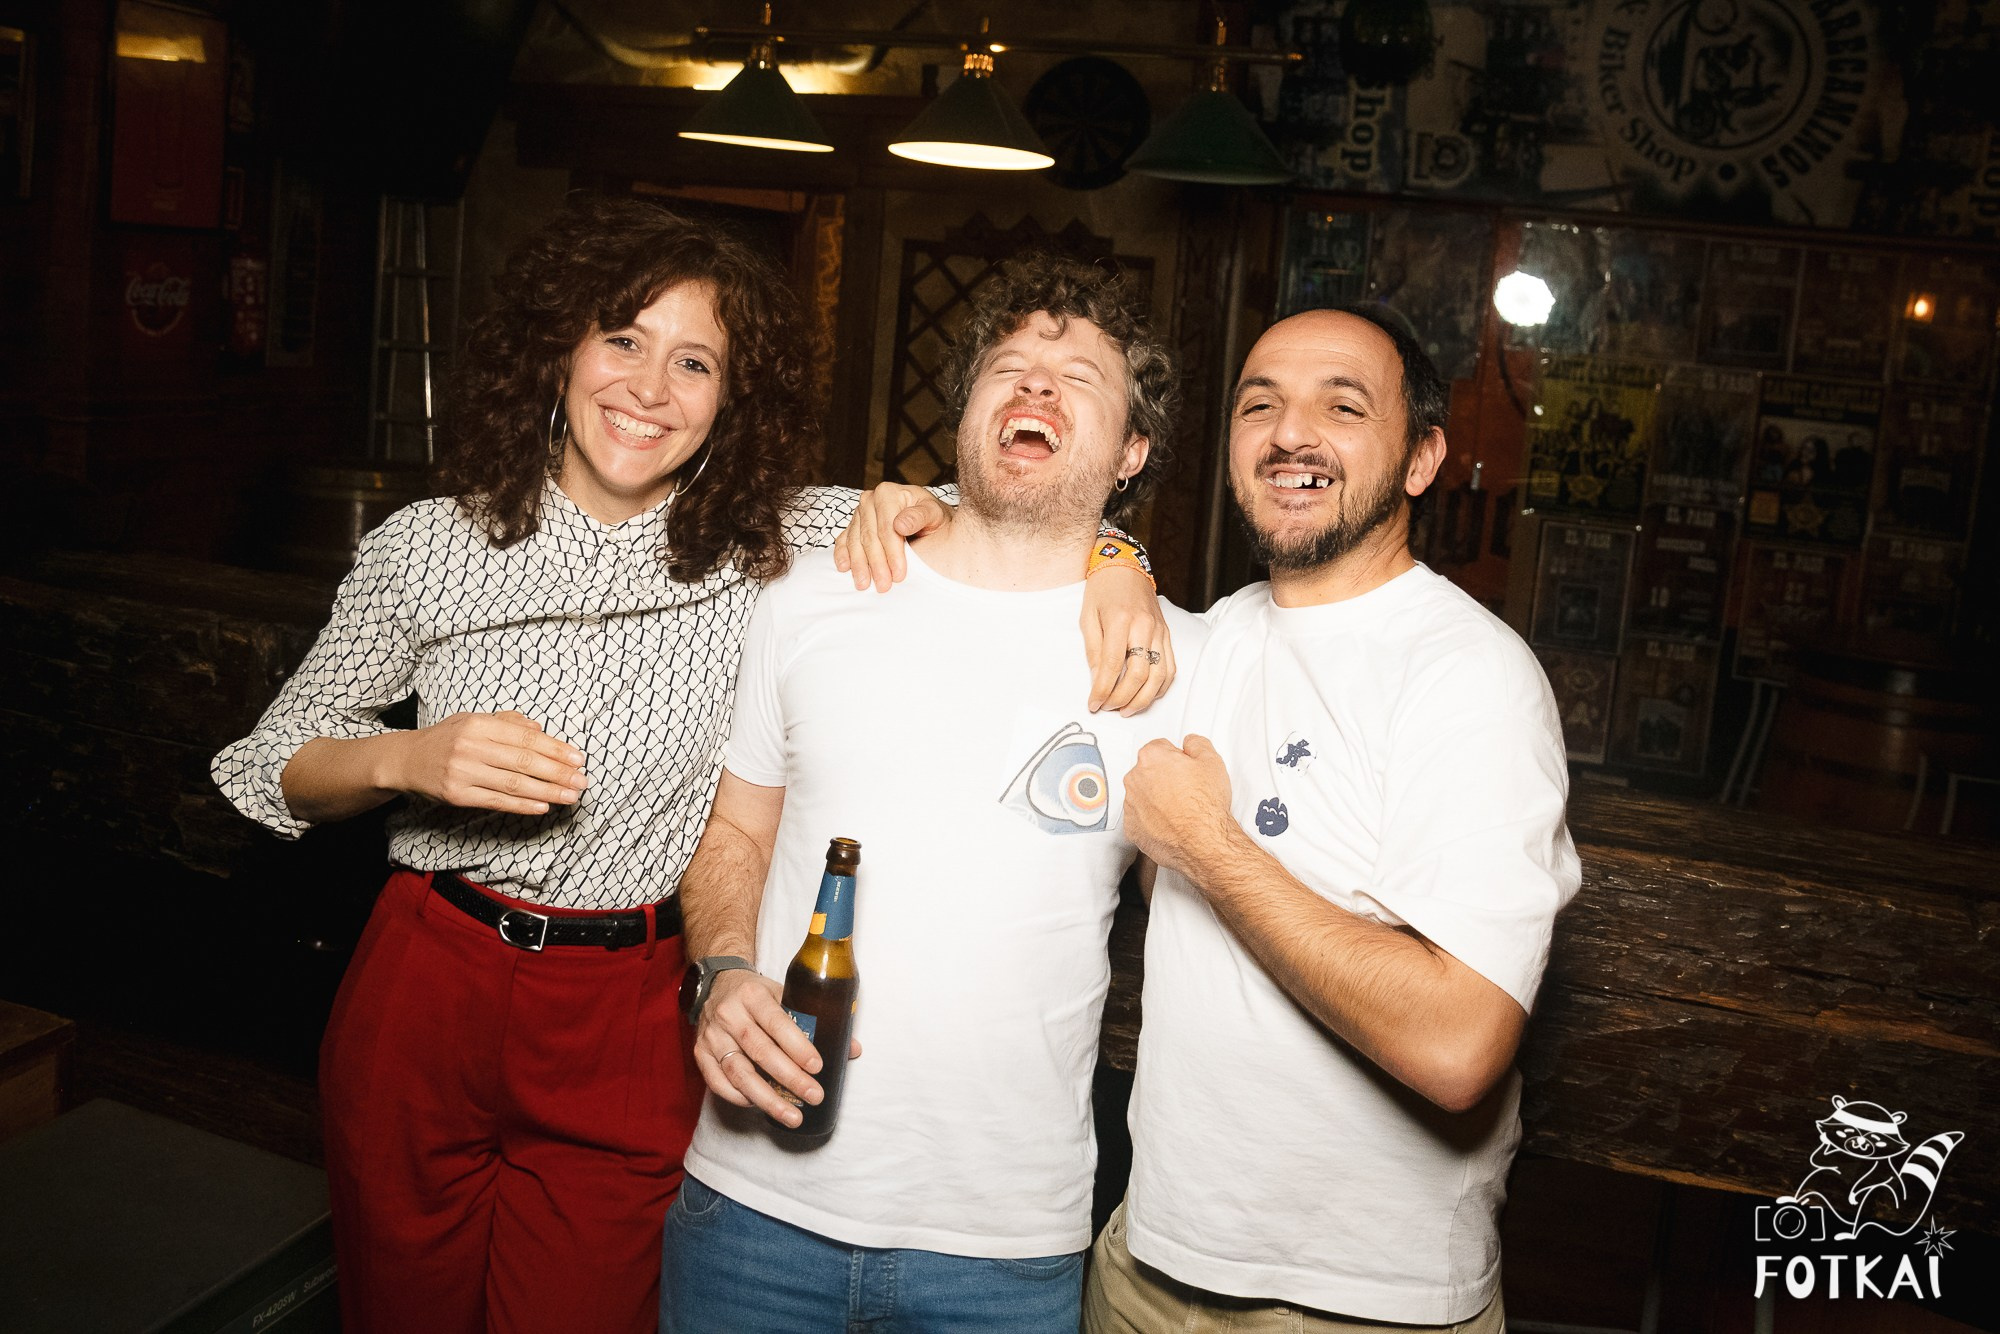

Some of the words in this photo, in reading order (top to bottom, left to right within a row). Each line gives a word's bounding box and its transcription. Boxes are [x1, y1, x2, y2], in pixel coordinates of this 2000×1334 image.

[1340, 92, 1385, 172] hop
[1598, 24, 1631, 115] Biker
[1620, 116, 1697, 183] Shop
